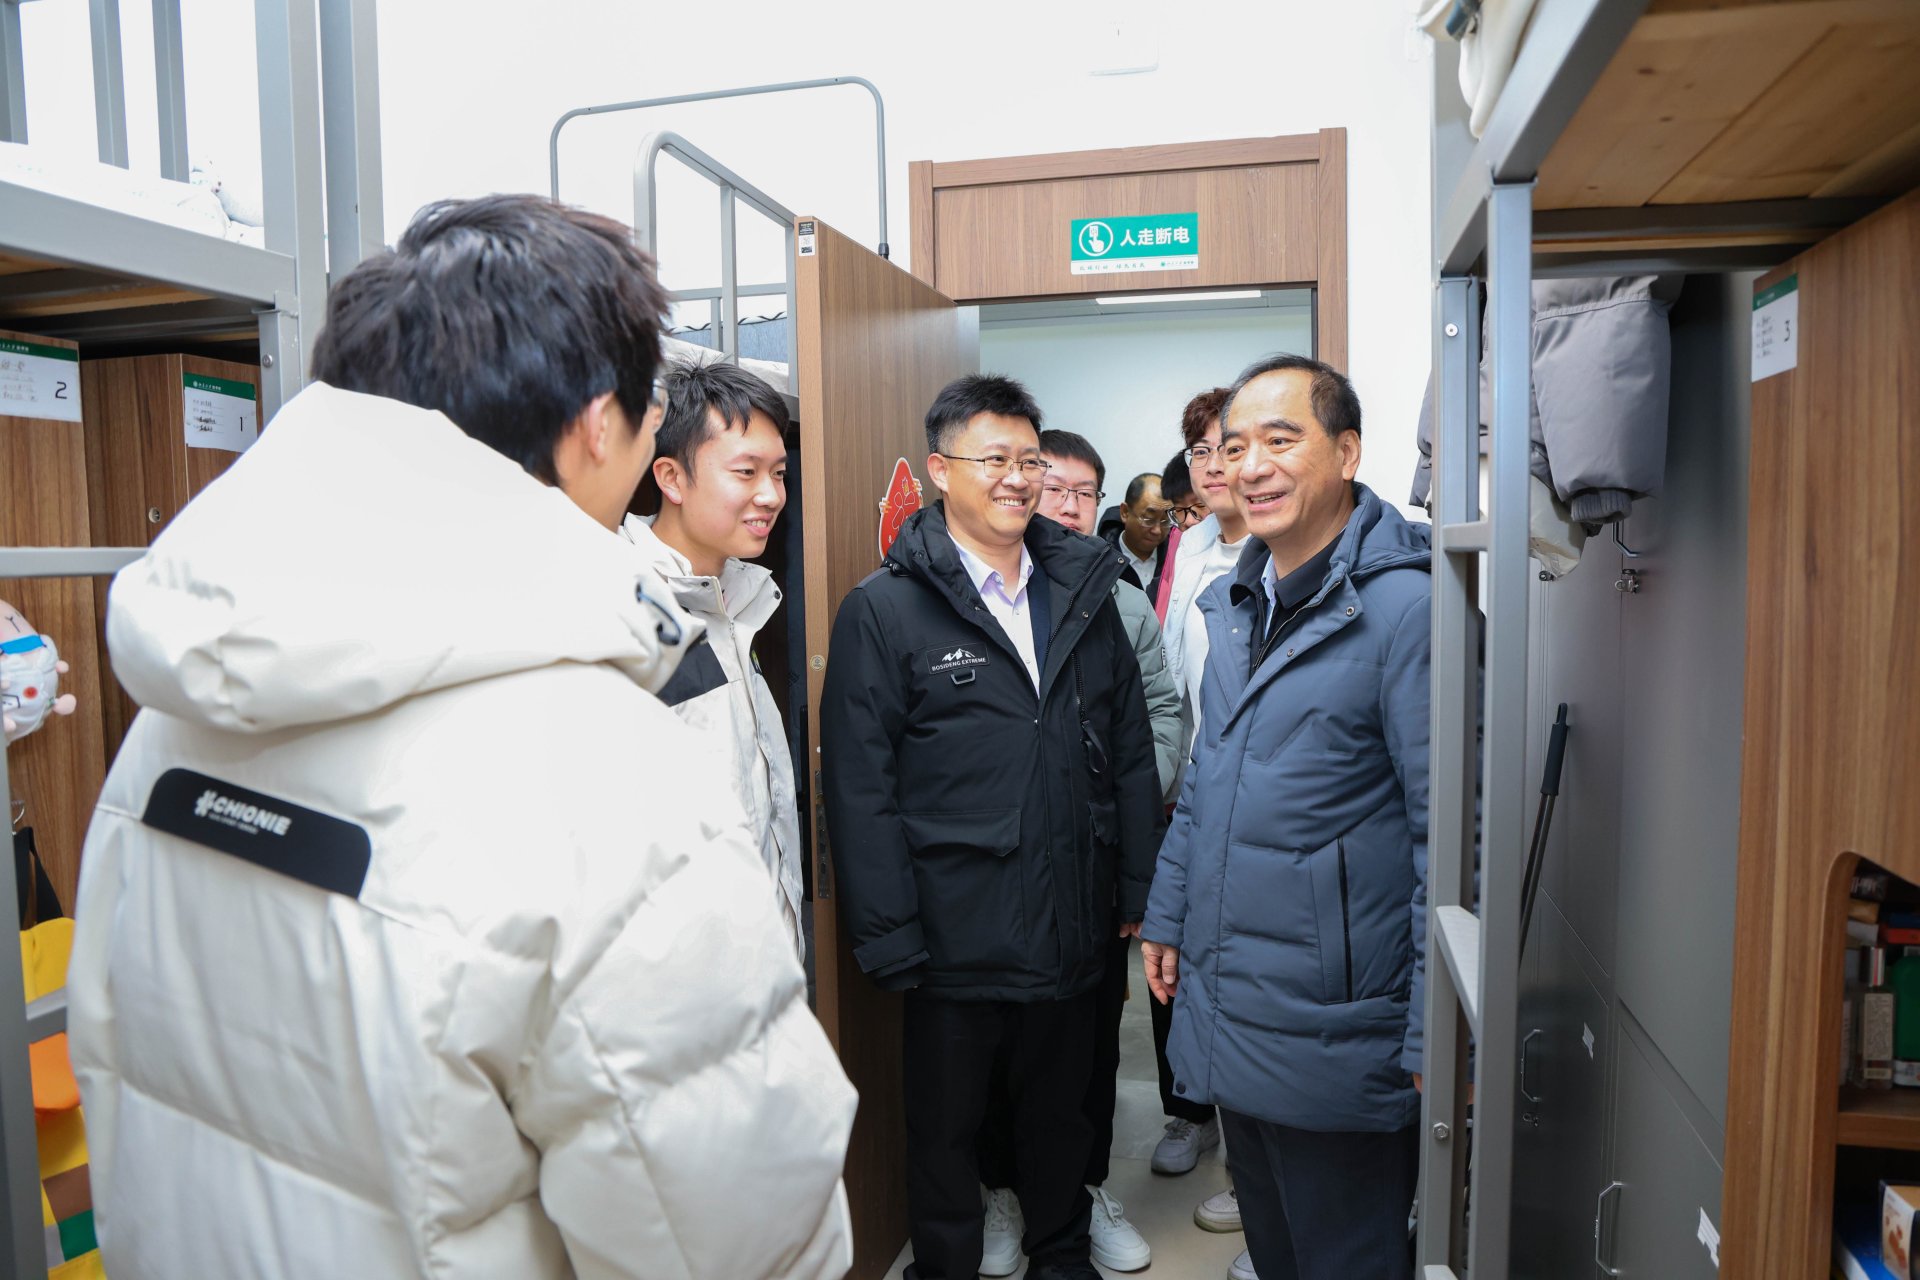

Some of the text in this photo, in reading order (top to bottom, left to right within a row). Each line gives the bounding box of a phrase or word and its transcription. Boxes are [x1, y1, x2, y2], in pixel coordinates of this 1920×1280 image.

[1120, 226, 1190, 247] 人走断电
[1783, 319, 1792, 343] 3
[55, 381, 68, 399] 2
[931, 657, 987, 672] BOSIDENG EXTREME
